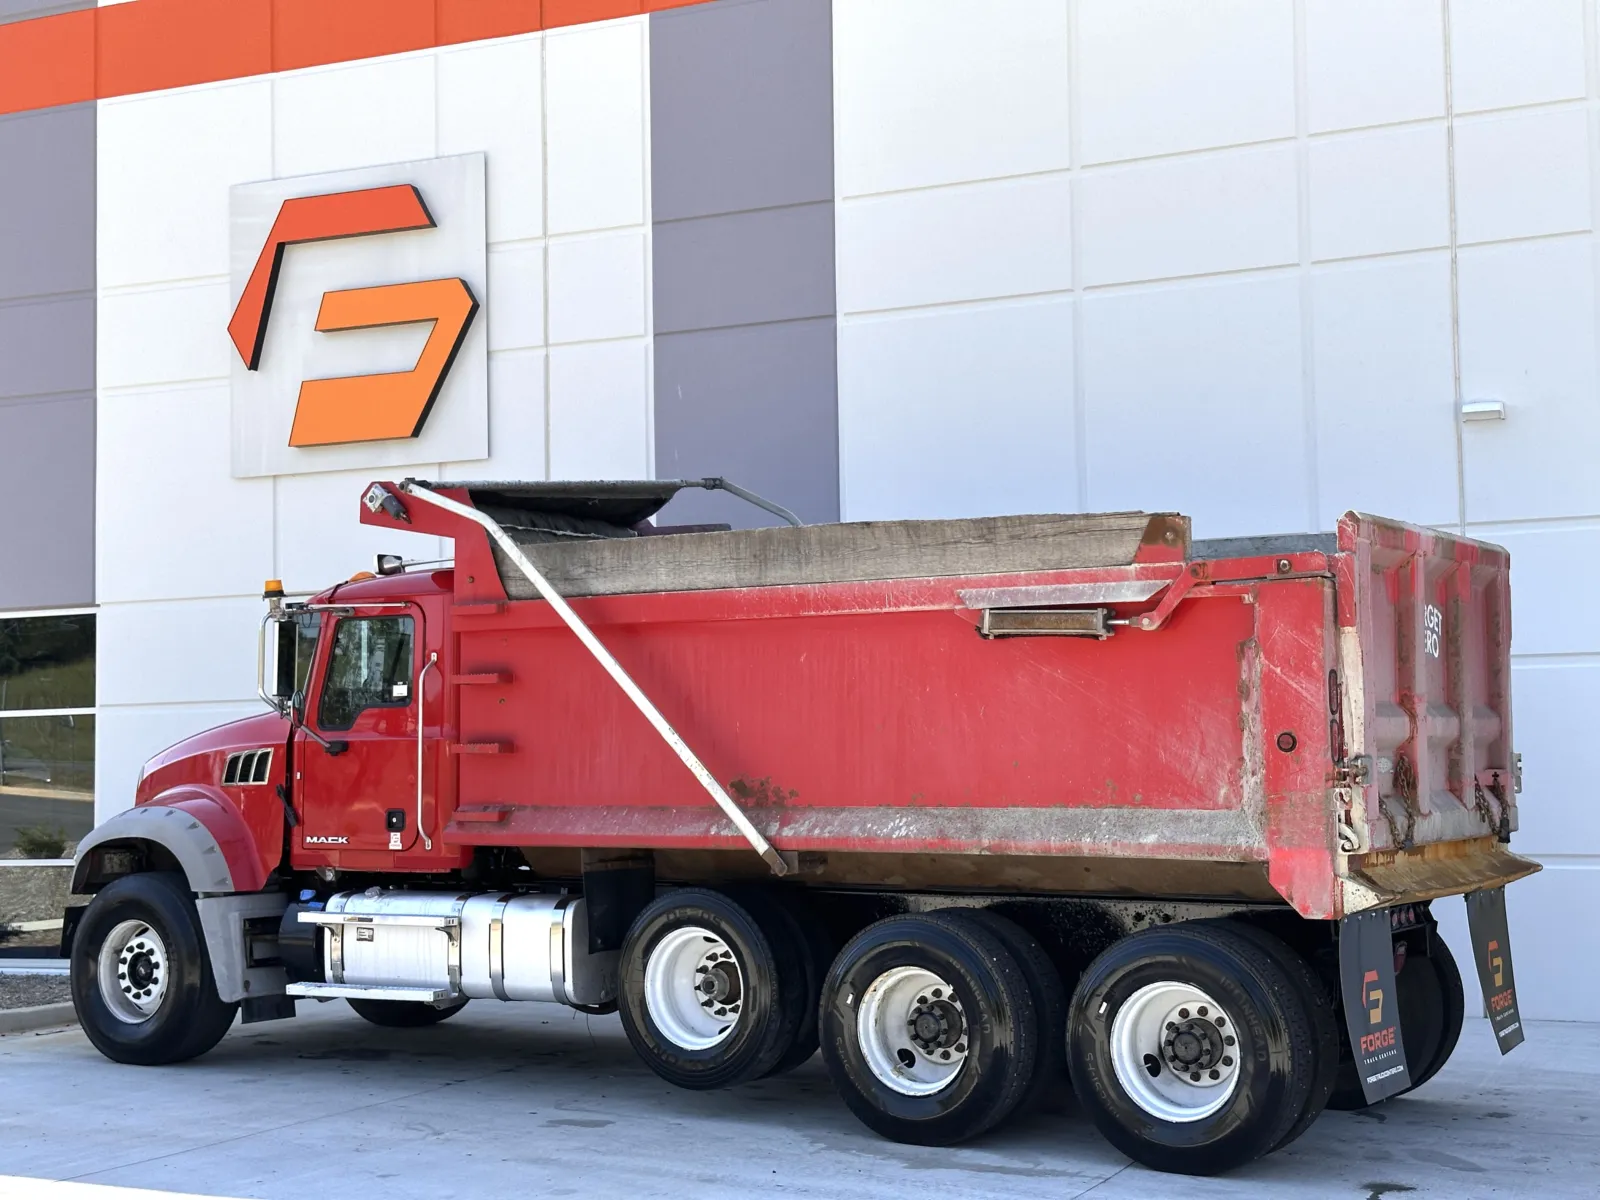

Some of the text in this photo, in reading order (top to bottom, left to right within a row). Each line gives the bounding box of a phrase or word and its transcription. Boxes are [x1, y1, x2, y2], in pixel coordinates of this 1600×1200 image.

[306, 836, 349, 844] MACK
[1491, 988, 1513, 1013] FORGE
[1360, 1026, 1396, 1056] FORGE
